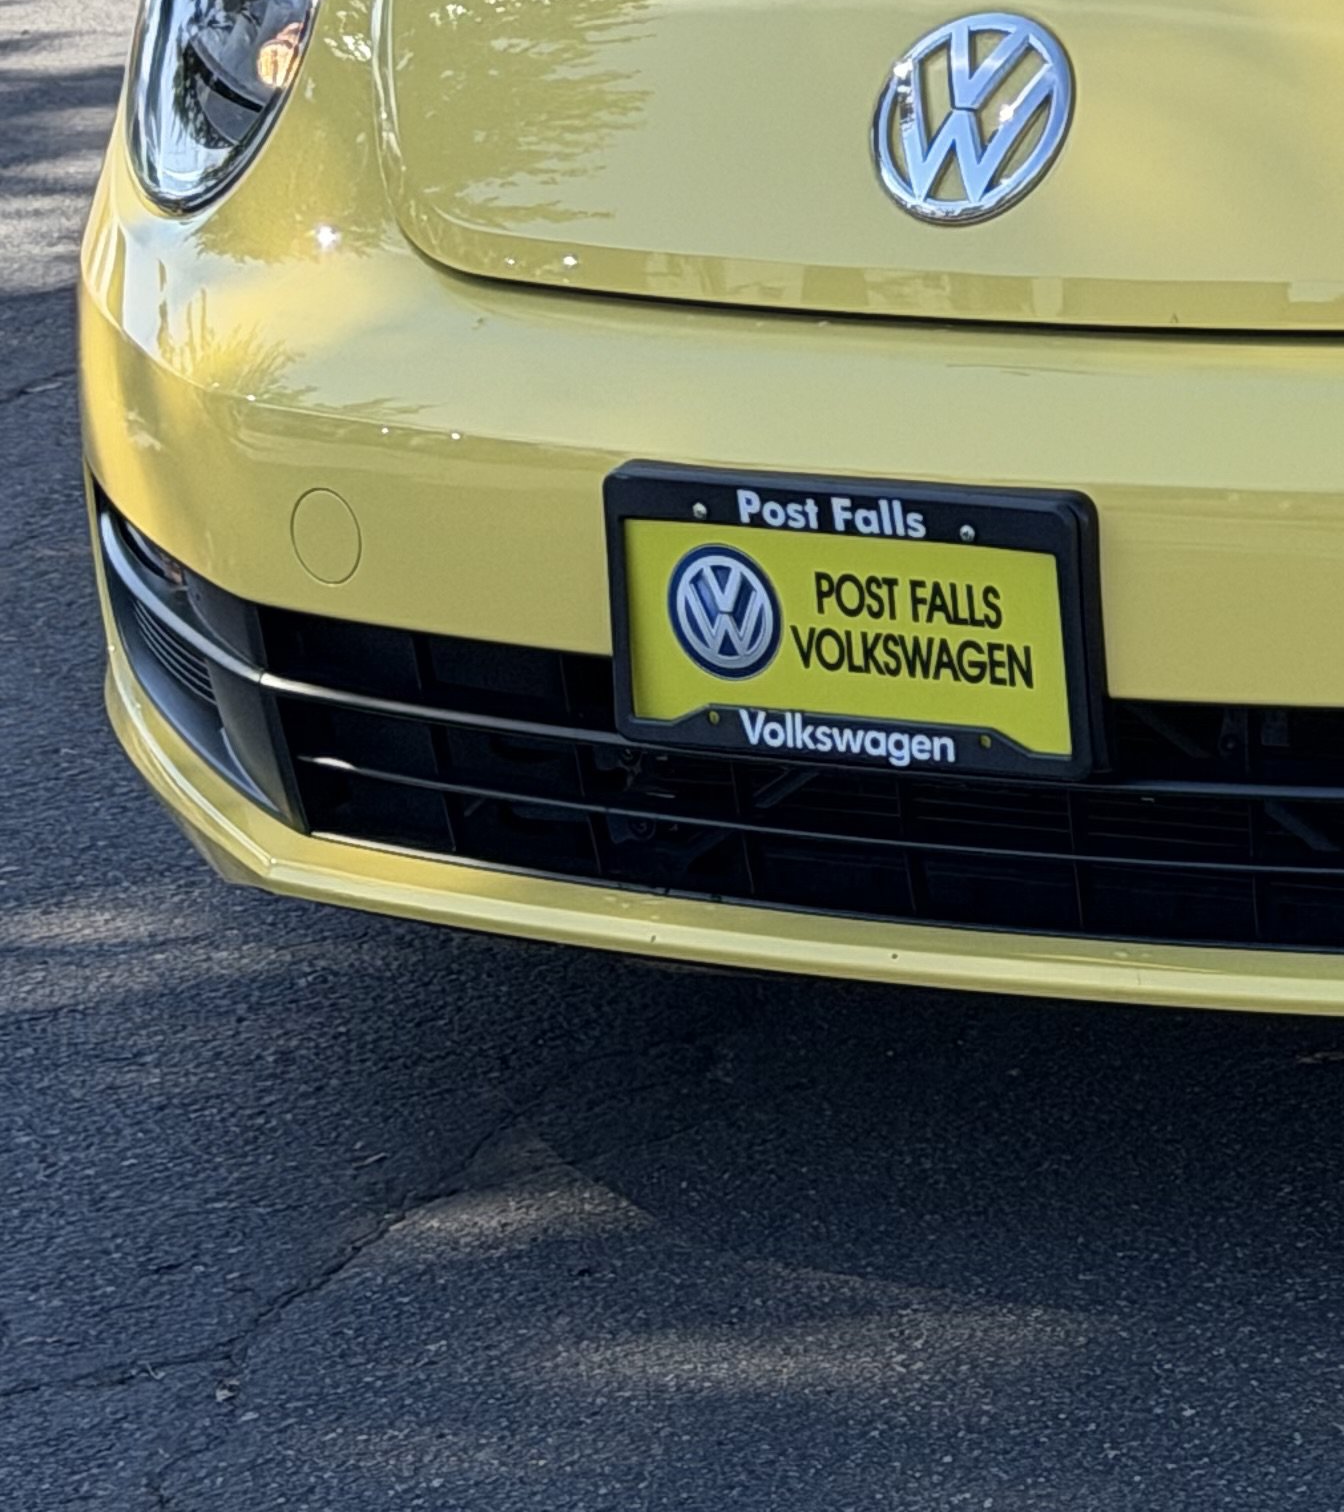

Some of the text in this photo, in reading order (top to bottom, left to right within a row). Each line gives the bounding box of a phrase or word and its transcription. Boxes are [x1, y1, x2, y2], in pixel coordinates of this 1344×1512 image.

[737, 489, 927, 538] Post Falls
[815, 571, 1003, 629] POST FALLS
[790, 625, 1035, 689] VOLKSWAGEN
[739, 709, 955, 766] Volkswagen
